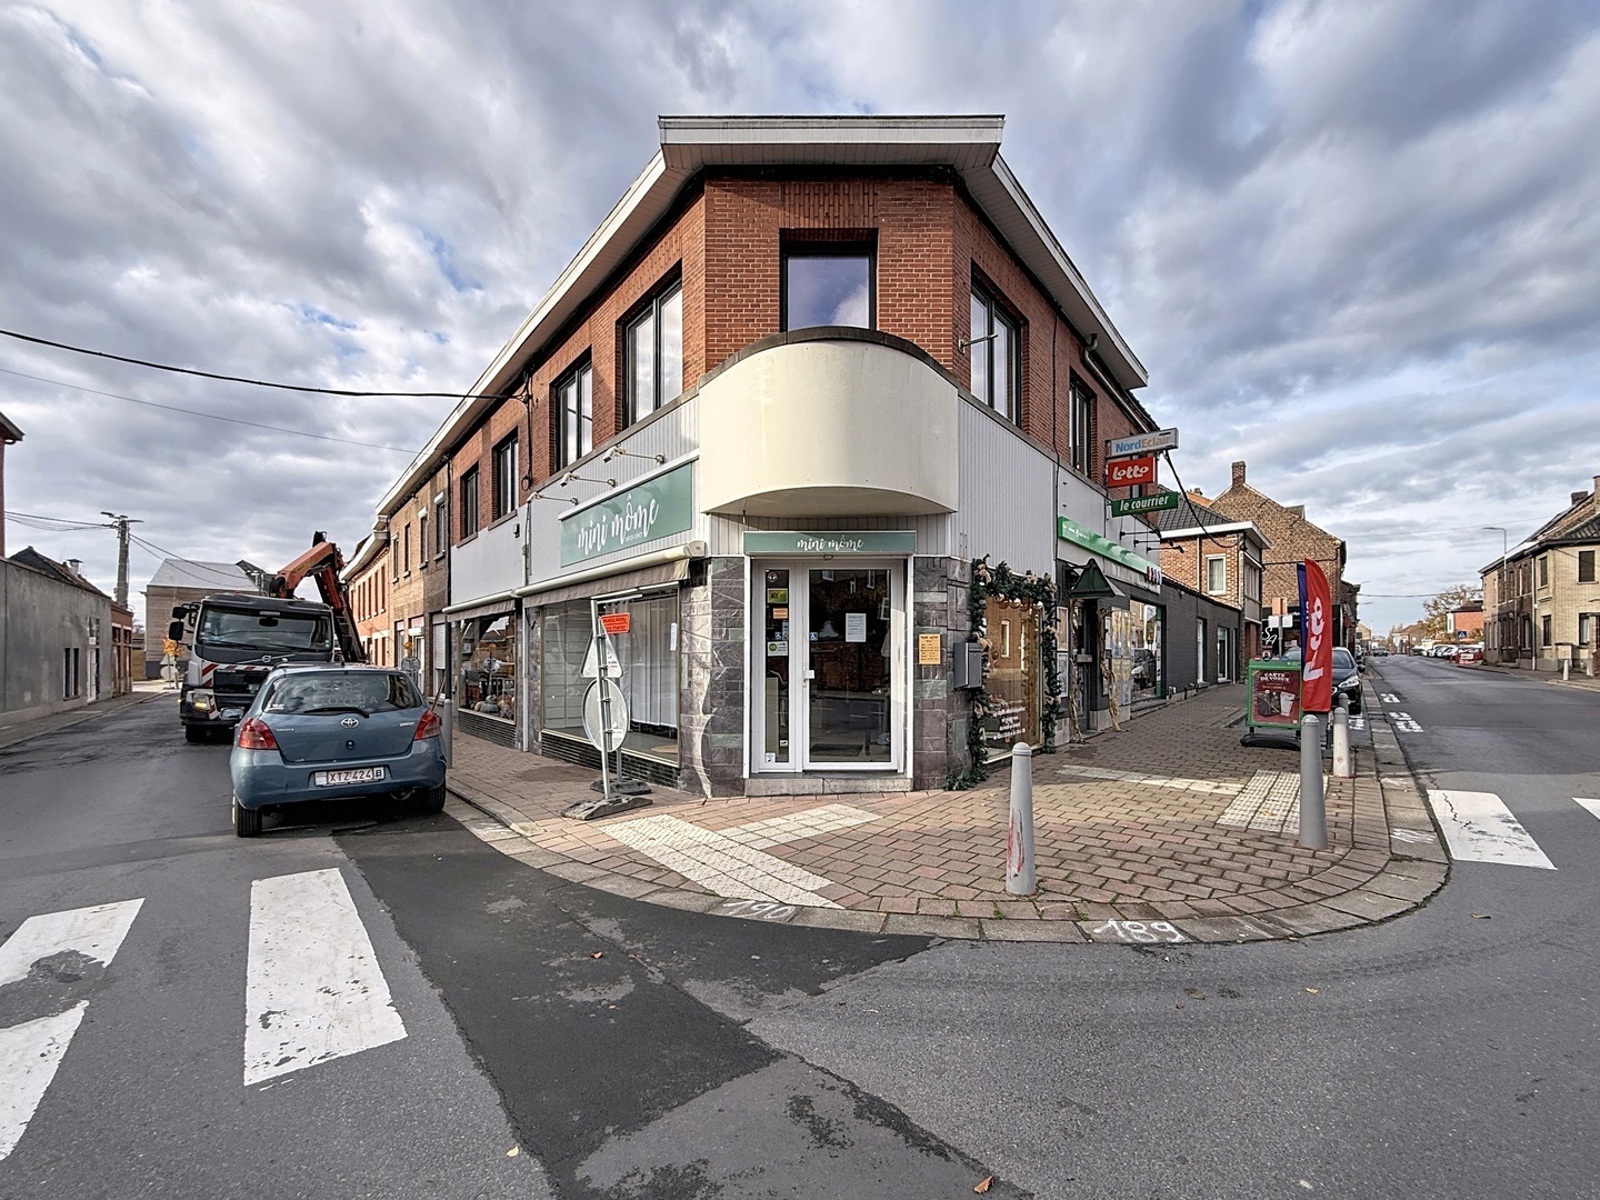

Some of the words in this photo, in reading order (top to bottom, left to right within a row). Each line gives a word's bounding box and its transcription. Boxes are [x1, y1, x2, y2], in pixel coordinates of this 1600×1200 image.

[1112, 464, 1150, 481] Lotto
[1119, 500, 1129, 511] le
[1130, 495, 1169, 510] courrier
[578, 514, 610, 556] mini
[611, 493, 660, 545] môme
[797, 538, 826, 552] mini
[1093, 918, 1186, 942] 189
